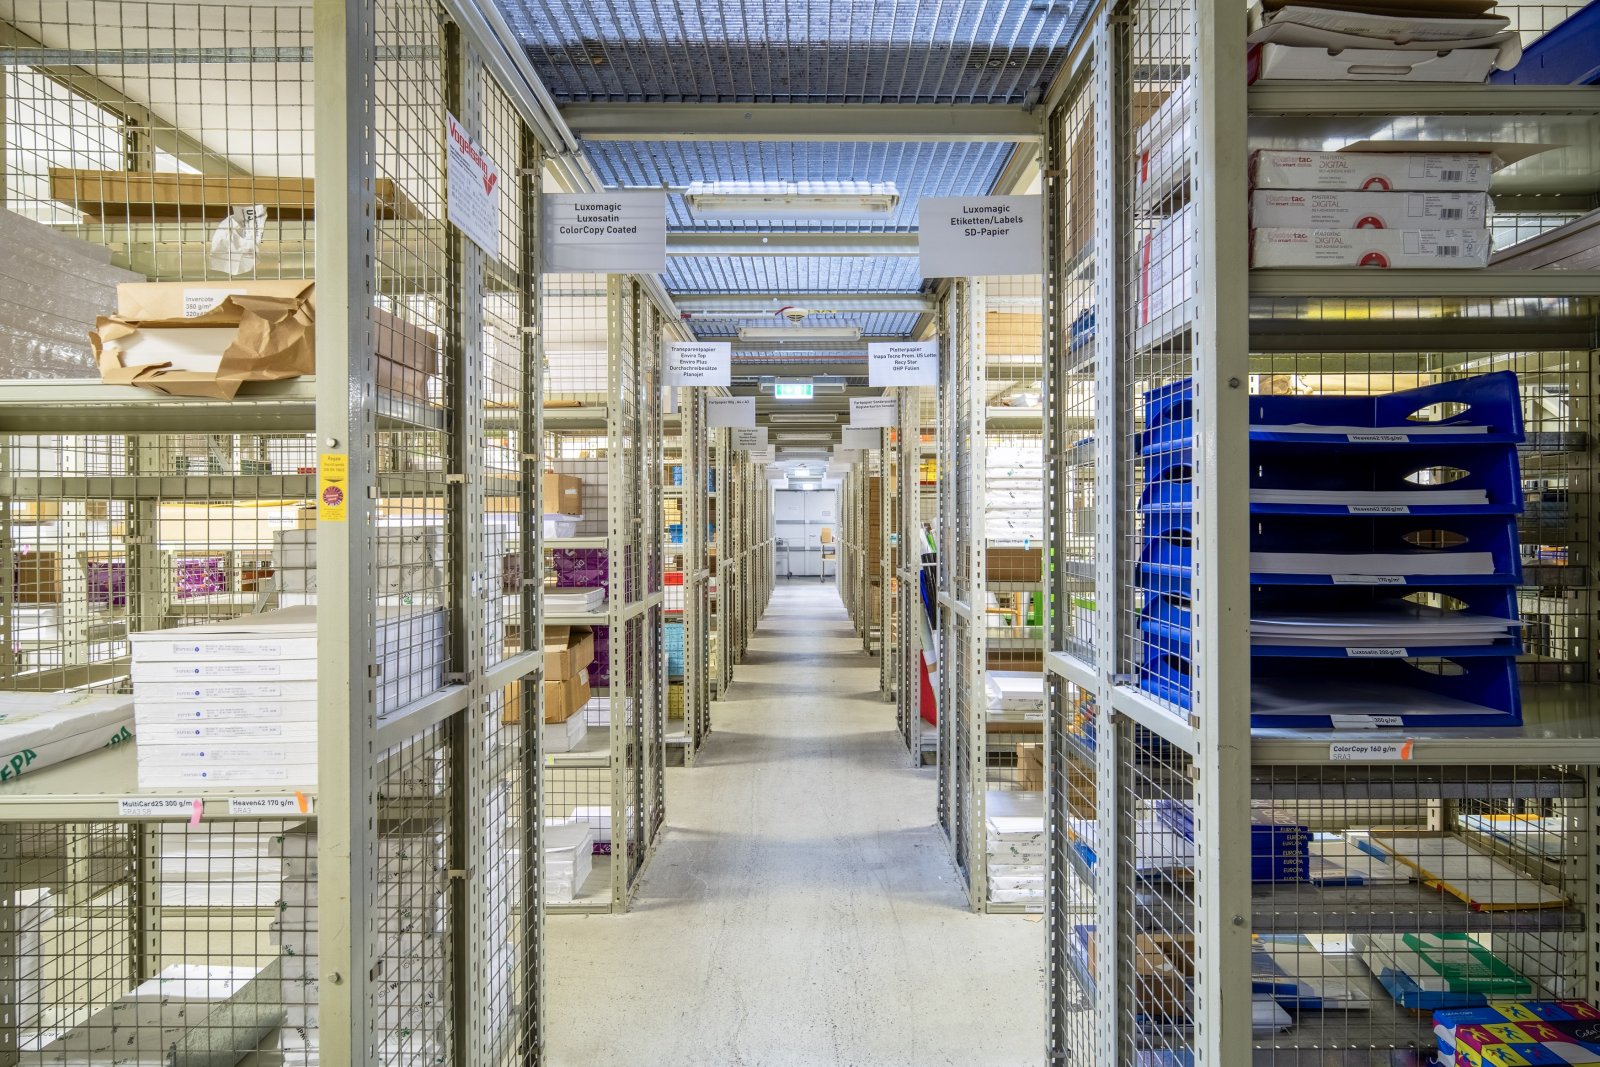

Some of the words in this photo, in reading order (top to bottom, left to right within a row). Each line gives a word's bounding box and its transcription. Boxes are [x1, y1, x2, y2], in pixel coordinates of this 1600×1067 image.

[448, 116, 488, 179] Vogelsang
[574, 203, 621, 212] Luxomagic
[963, 205, 1010, 214] Luxomagic
[951, 216, 1023, 225] Etiketten/Labels
[560, 226, 604, 235] ColorCopy
[965, 228, 1009, 237] SD-Papier
